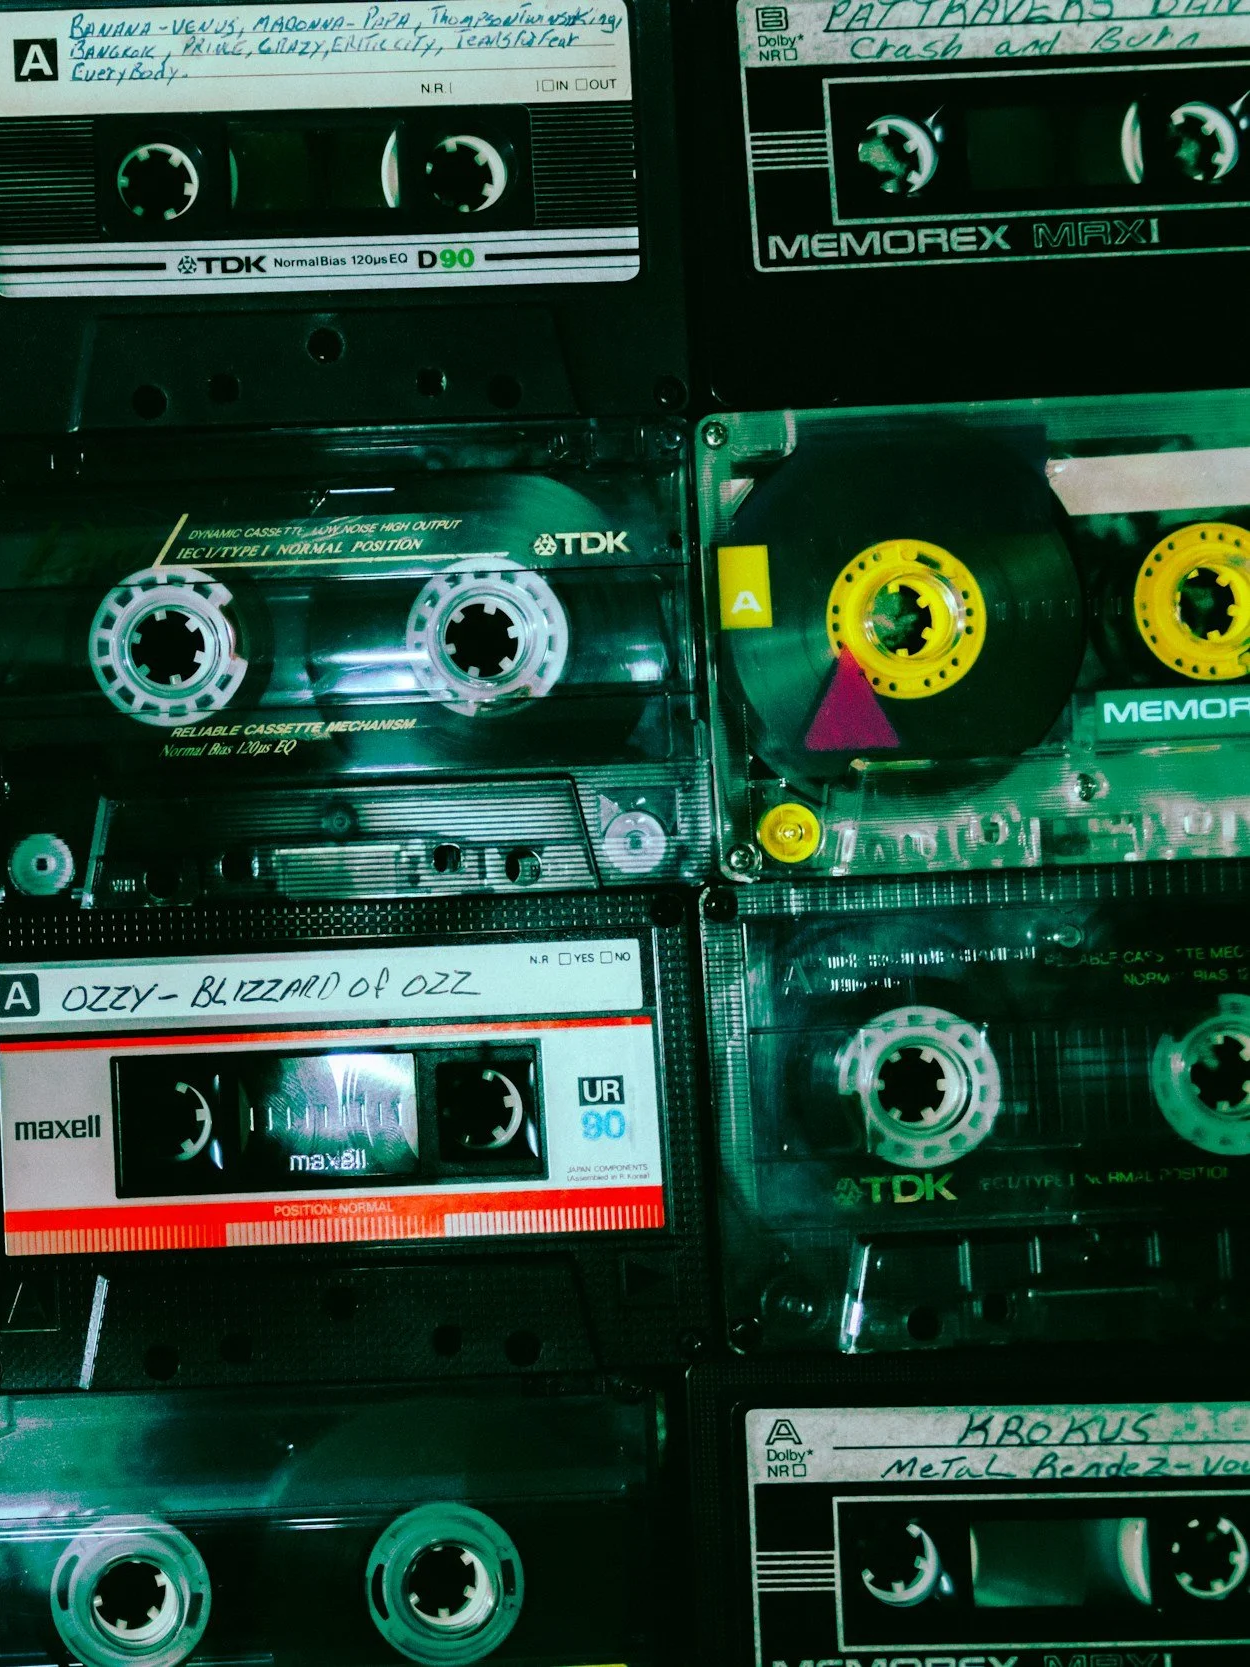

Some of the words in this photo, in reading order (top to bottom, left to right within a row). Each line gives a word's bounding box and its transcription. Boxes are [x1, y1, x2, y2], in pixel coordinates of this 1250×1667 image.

[755, 6, 789, 31] B
[20, 45, 53, 77] A
[759, 50, 781, 62] NR
[555, 80, 569, 92] IN
[589, 78, 617, 91] OUT
[767, 224, 1012, 260] MEMOREX
[197, 255, 267, 274] TDK
[188, 527, 242, 541] DYNAMIC
[342, 523, 379, 535] NOISE
[380, 520, 410, 533] HIGH
[411, 518, 463, 532] OUTPUT
[277, 540, 343, 556] NORMAL
[351, 537, 424, 554] POSITION
[554, 530, 630, 555] TDK
[731, 590, 762, 614] A
[170, 724, 242, 738] RELIABLE
[243, 721, 327, 736] CASSETTE
[327, 718, 418, 732] MECHANISM
[158, 743, 205, 758] Normal
[207, 740, 233, 756] Bias
[273, 738, 298, 755] EQ
[574, 952, 595, 963] YES
[614, 951, 631, 961] NO
[4, 981, 33, 1010] A
[190, 970, 342, 1009] BLIZZARD
[582, 1079, 621, 1102] UR
[14, 1114, 101, 1141] maxell
[860, 1171, 959, 1204] TDK
[765, 1419, 802, 1446] A
[767, 1465, 791, 1478] NR
